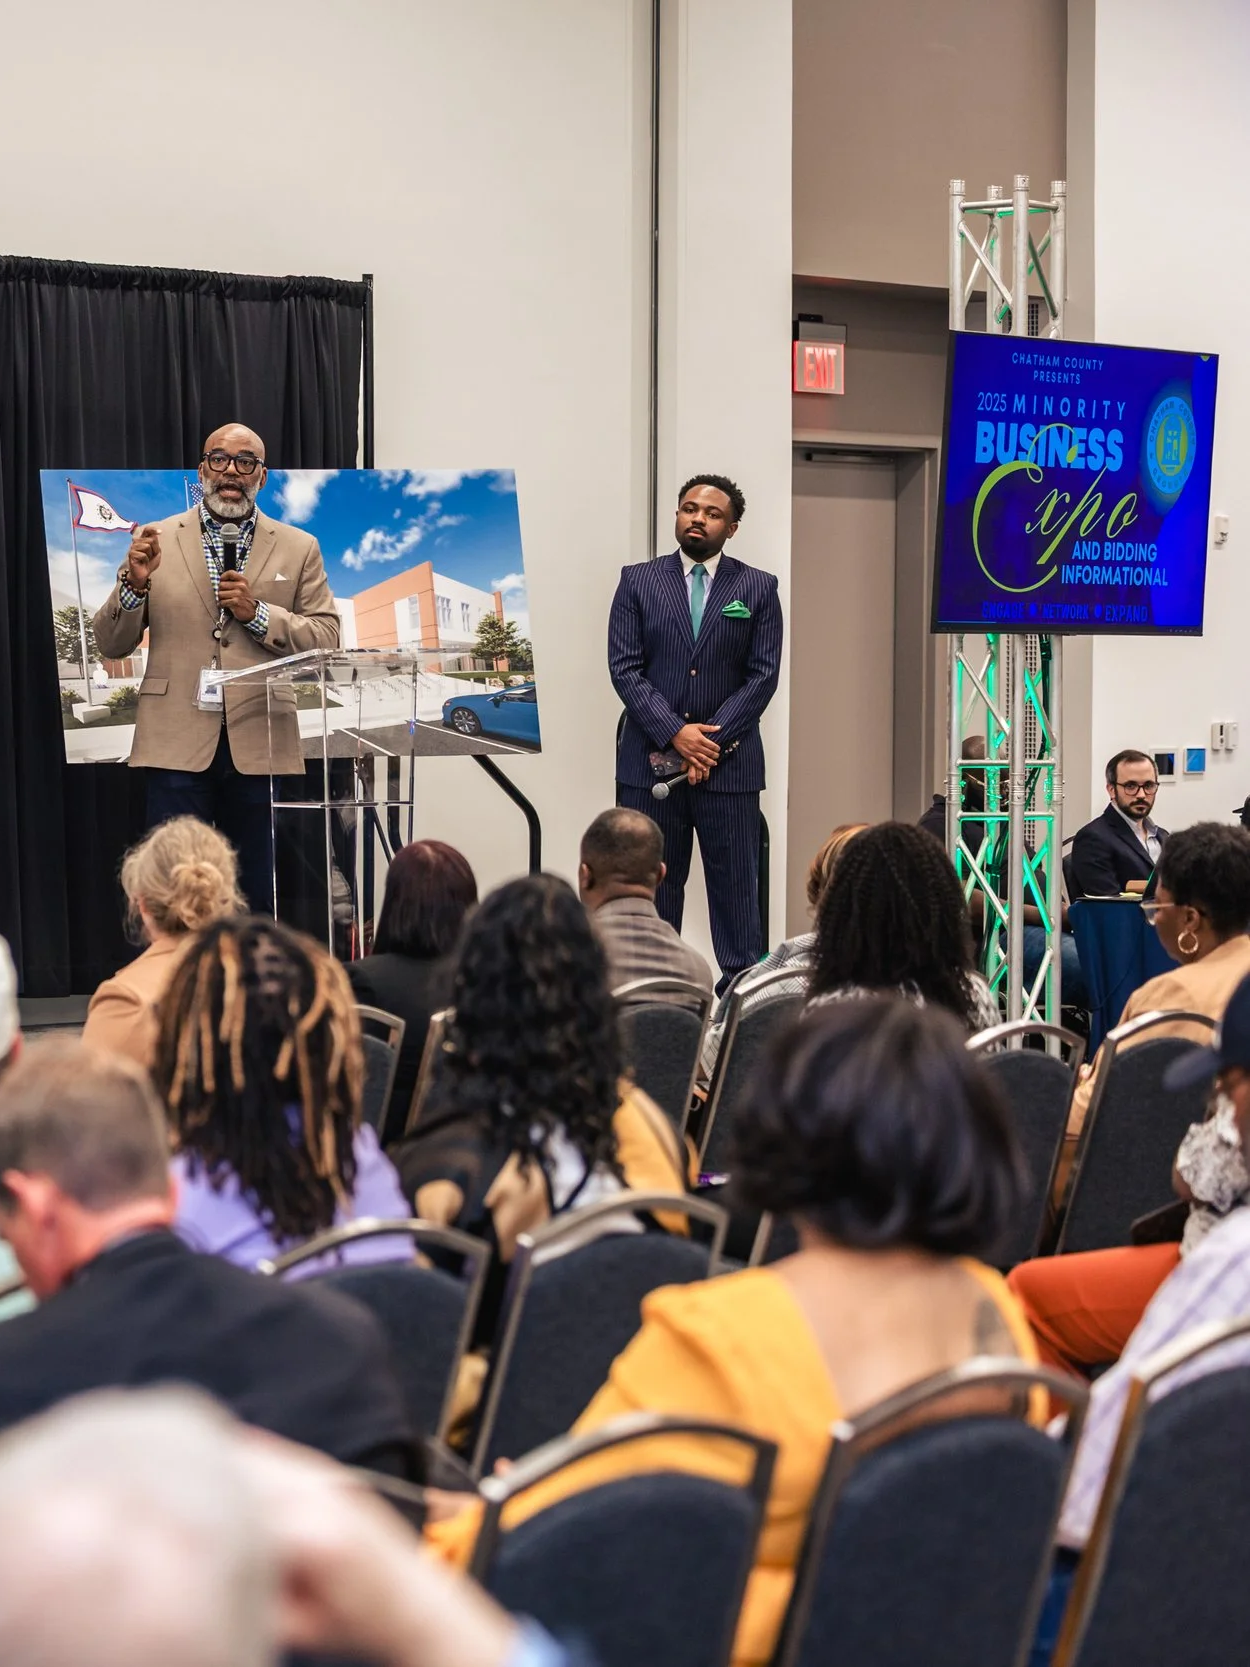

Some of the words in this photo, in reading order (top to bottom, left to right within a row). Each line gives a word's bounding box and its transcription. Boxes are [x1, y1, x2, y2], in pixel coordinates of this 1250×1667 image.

[804, 346, 837, 389] EXIT
[1012, 352, 1060, 368] CHATHAM
[1064, 357, 1104, 371] COUNTY
[1033, 370, 1081, 385] PRESENTS
[977, 392, 1007, 412] 2025
[1012, 393, 1126, 421] MINORITY
[974, 421, 1124, 472] BUSINESS
[972, 423, 1139, 593] Expo
[1072, 540, 1100, 561] AND
[1103, 541, 1157, 563] BIDDING
[1061, 564, 1168, 587] INFORMATIONAL
[981, 601, 1024, 619] ENGAGE
[1042, 603, 1089, 619] NETWORK
[1105, 604, 1148, 622] EXPAND
